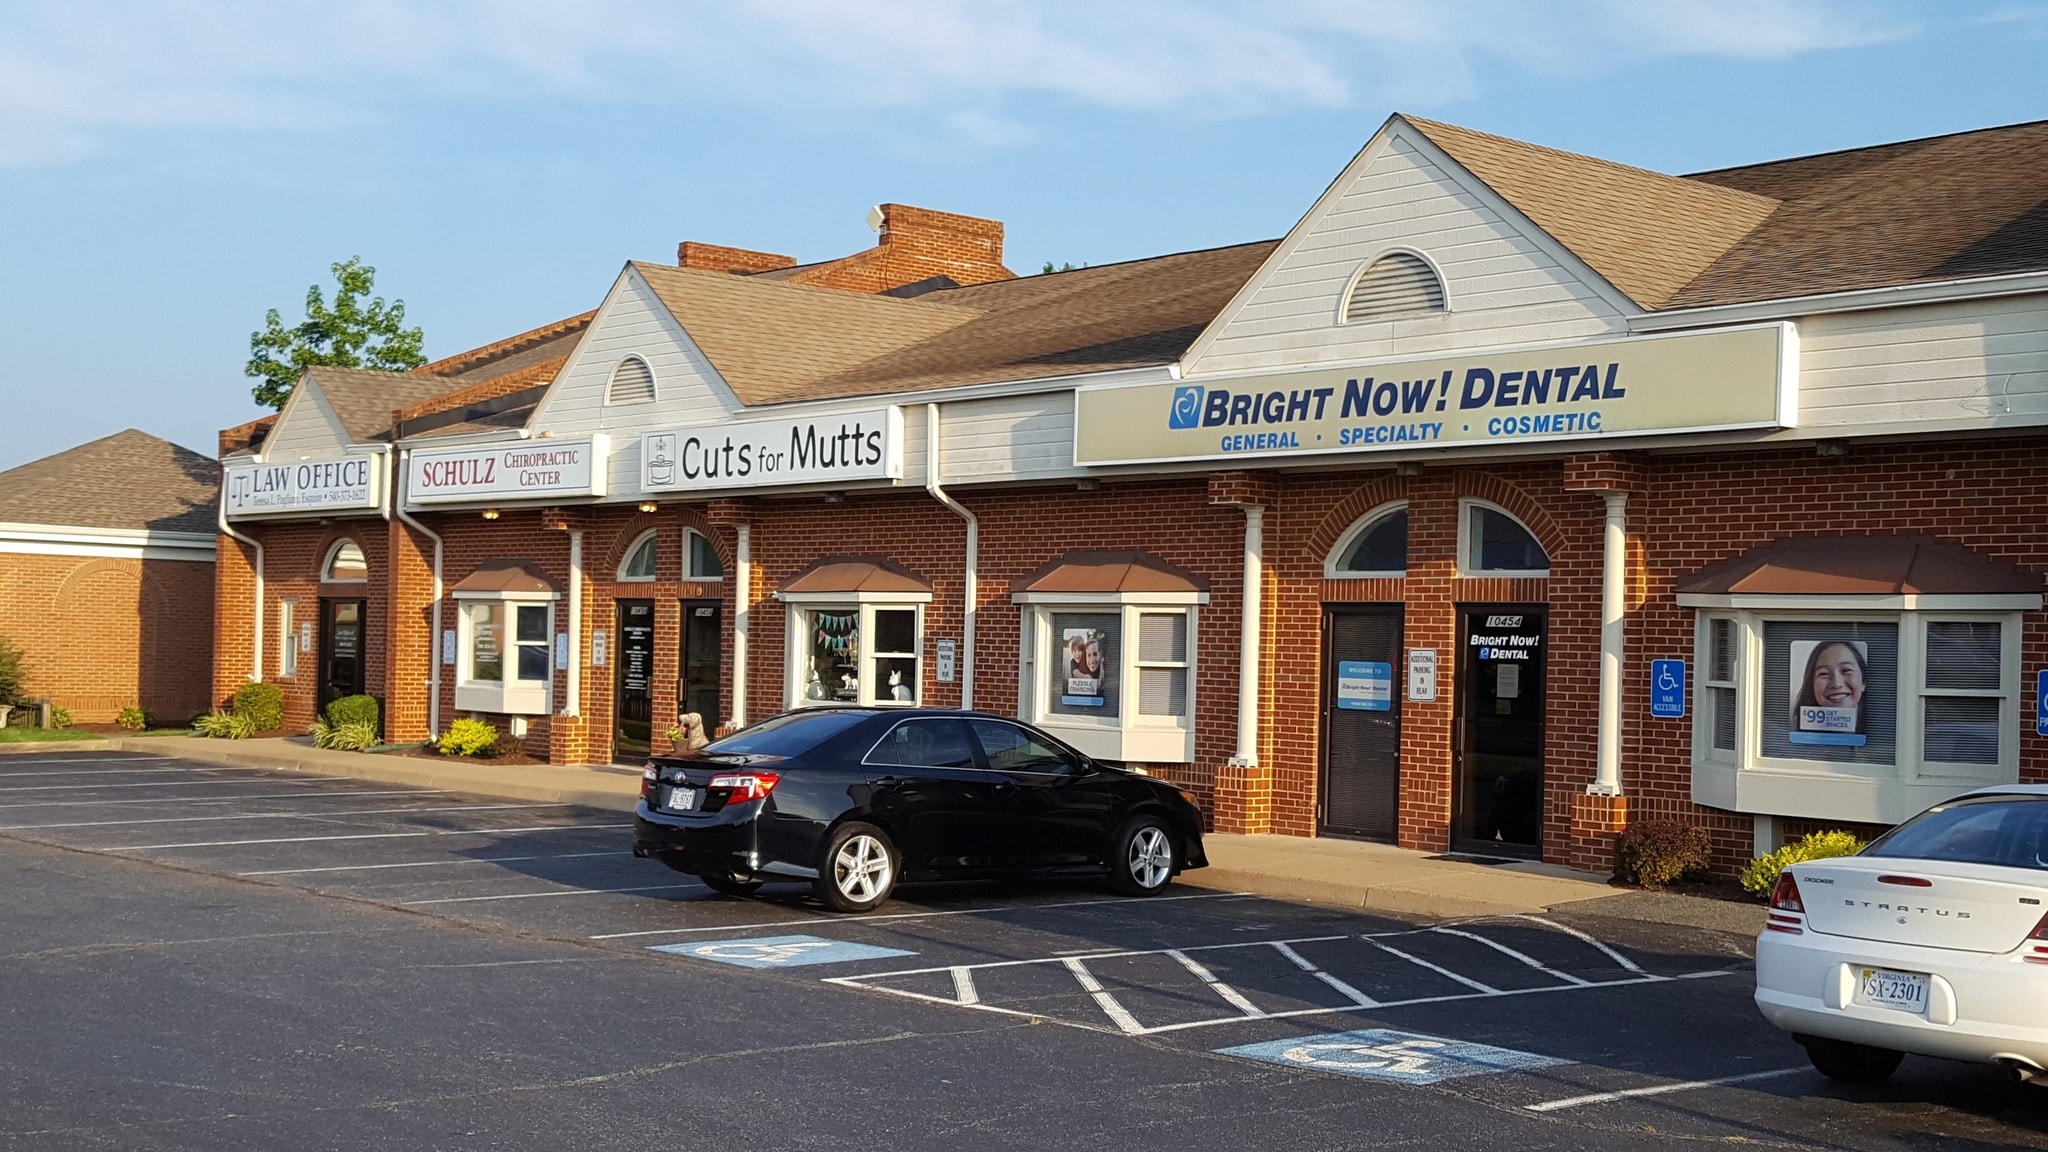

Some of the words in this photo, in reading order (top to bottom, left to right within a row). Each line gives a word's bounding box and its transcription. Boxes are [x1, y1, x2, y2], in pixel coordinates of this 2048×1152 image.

[1202, 387, 1335, 428] BRIGHT
[1340, 370, 1453, 419] NOW!
[1459, 363, 1627, 410] DENTAL
[1221, 432, 1300, 452] GENERAL
[1339, 422, 1443, 446] SPECIALTY
[1488, 411, 1602, 436] COSMETIC
[682, 437, 752, 479] Cuts
[758, 445, 784, 473] for
[789, 422, 882, 471] Mutts
[504, 450, 579, 469] CHIROPRACTIC
[253, 466, 291, 493] LAW
[297, 460, 368, 490] OFFICE
[422, 457, 496, 488] SCHULZ
[519, 469, 561, 487] CENTER
[1488, 617, 1521, 626] 10454
[1470, 635, 1509, 646] BRIGHT
[1510, 635, 1540, 646] NOW!
[1411, 656, 1433, 664] ADDITIONAL
[1490, 648, 1529, 660] DENTAL
[1413, 666, 1431, 674] PARKING
[1420, 677, 1424, 685] IN
[1416, 687, 1428, 695] REAR
[1653, 704, 1682, 712] ACCESSIBLE
[1803, 876, 1834, 885] DODGE
[1844, 899, 1971, 919] STRATUS
[1877, 972, 1911, 983] VIRGINIA
[1862, 977, 1922, 1002] VSX-2301
